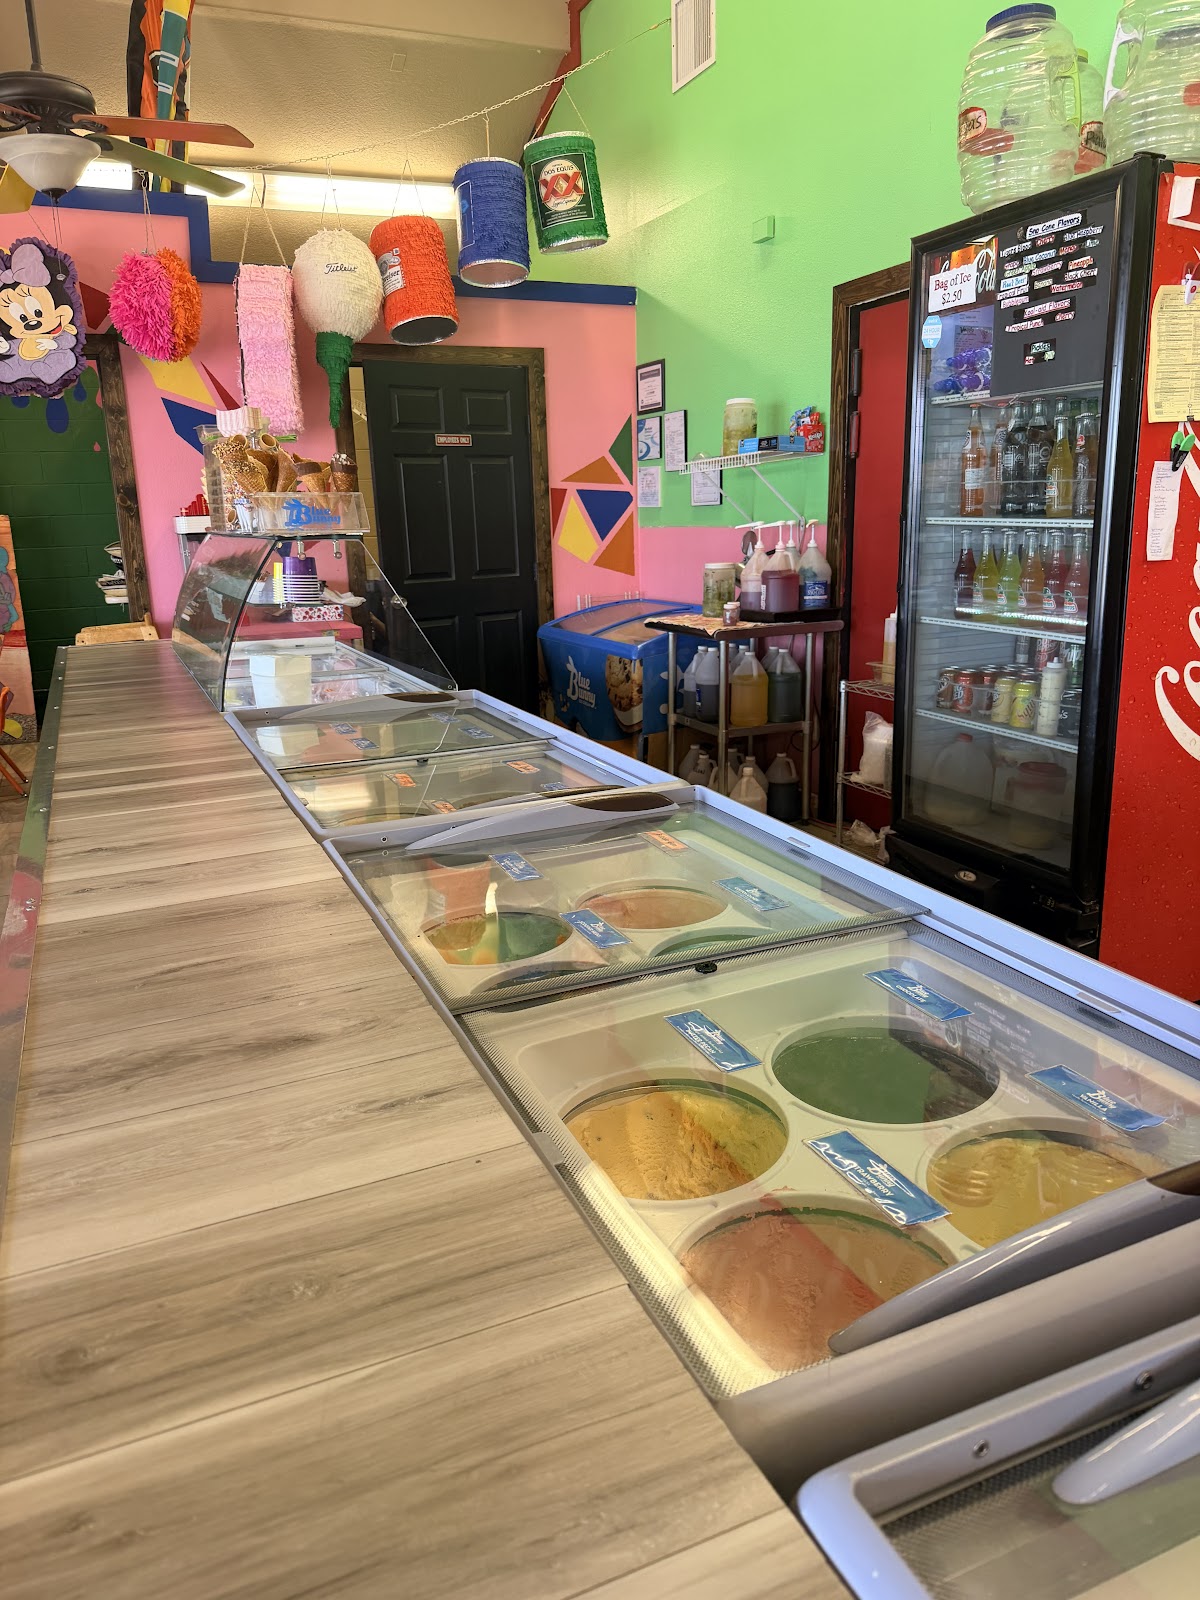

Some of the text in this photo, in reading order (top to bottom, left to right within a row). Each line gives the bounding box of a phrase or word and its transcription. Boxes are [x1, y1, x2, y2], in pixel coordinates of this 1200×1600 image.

[556, 164, 574, 173] EQUIS
[538, 170, 585, 204] XX
[1028, 215, 1080, 235] Sno Cone Flavors
[934, 272, 972, 291] Bag of Ice
[941, 289, 963, 305] $2.50
[895, 984, 926, 1003] CHOCOLATE
[1080, 1093, 1108, 1112] VANILLA
